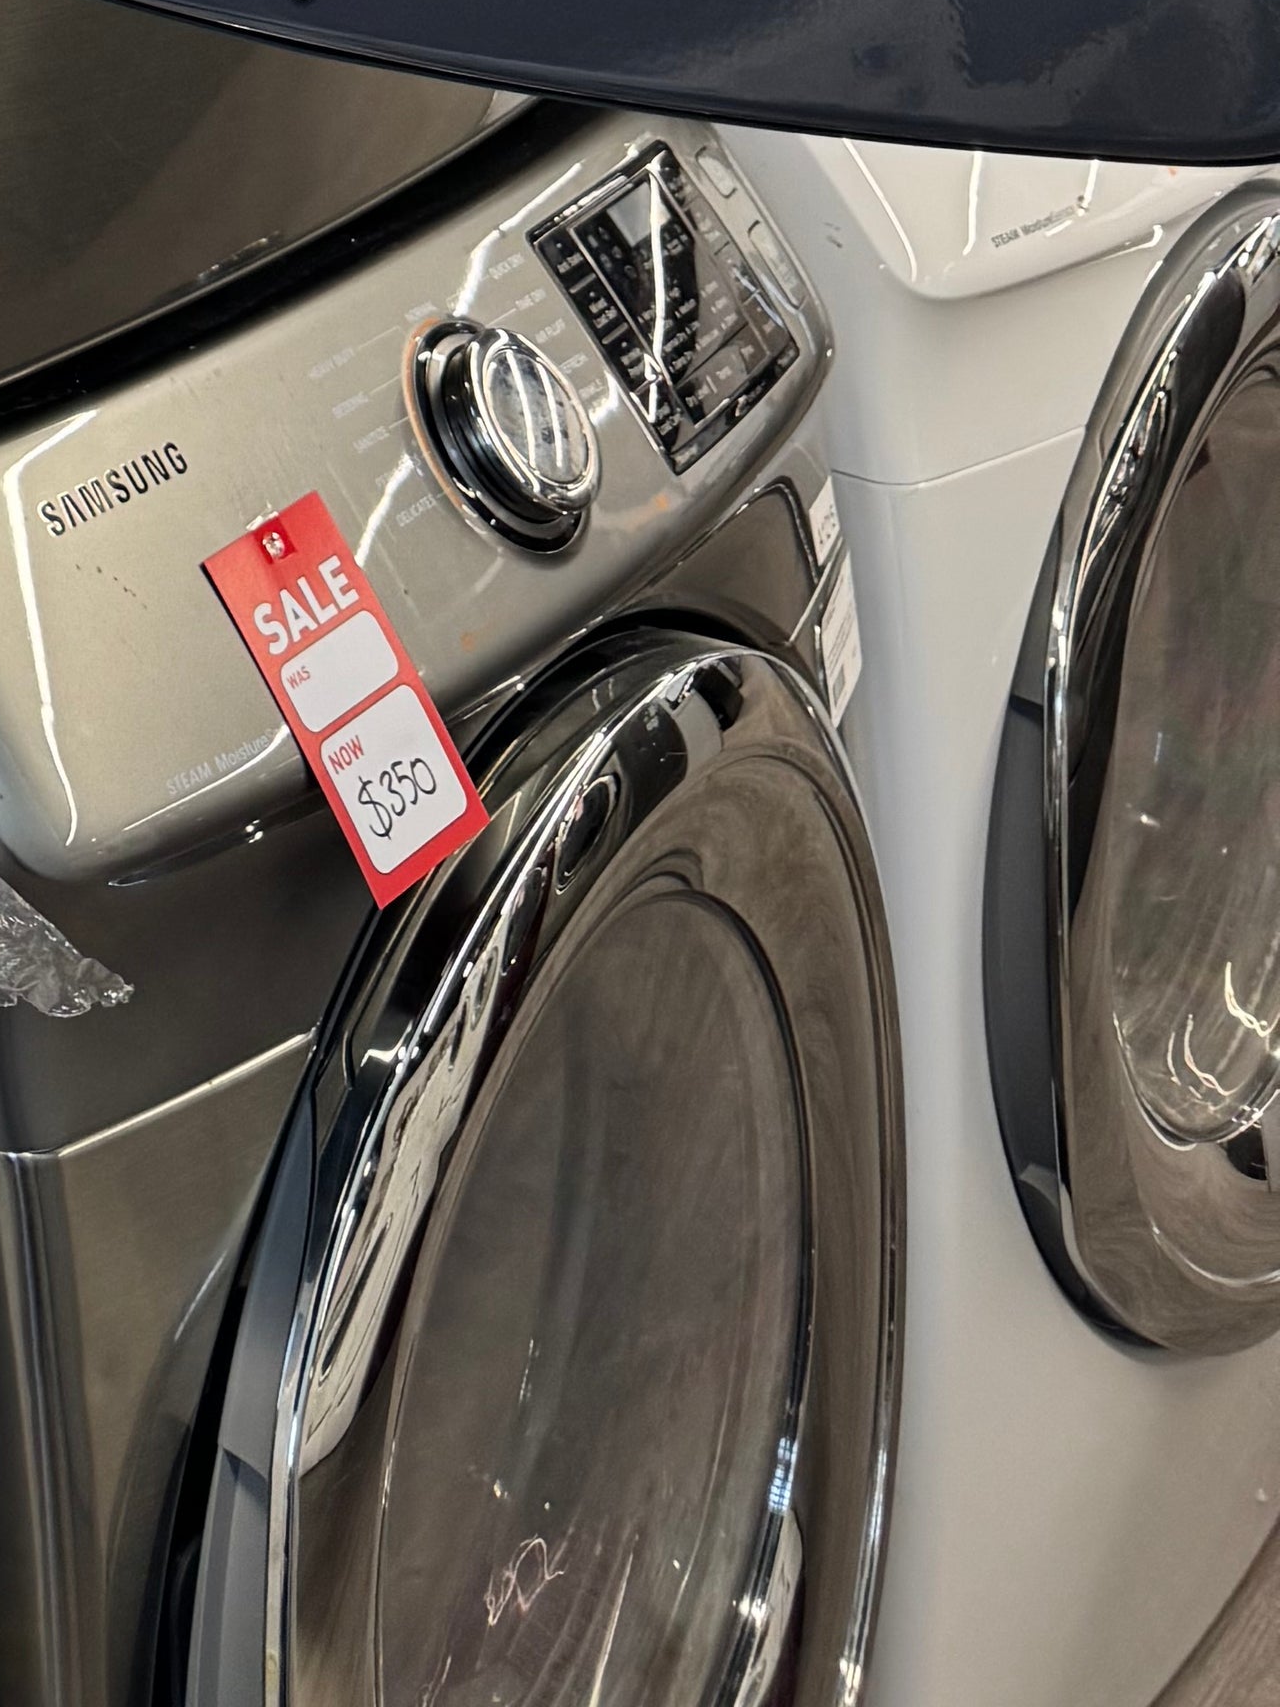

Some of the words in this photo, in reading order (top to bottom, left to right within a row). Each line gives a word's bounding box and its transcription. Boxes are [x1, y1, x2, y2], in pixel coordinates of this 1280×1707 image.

[37, 441, 189, 538] SAMSUNG
[253, 555, 359, 656] SALE
[286, 665, 312, 691] WAS
[166, 761, 212, 795] STEAM
[327, 735, 365, 775] NOW
[356, 756, 437, 840] $350
